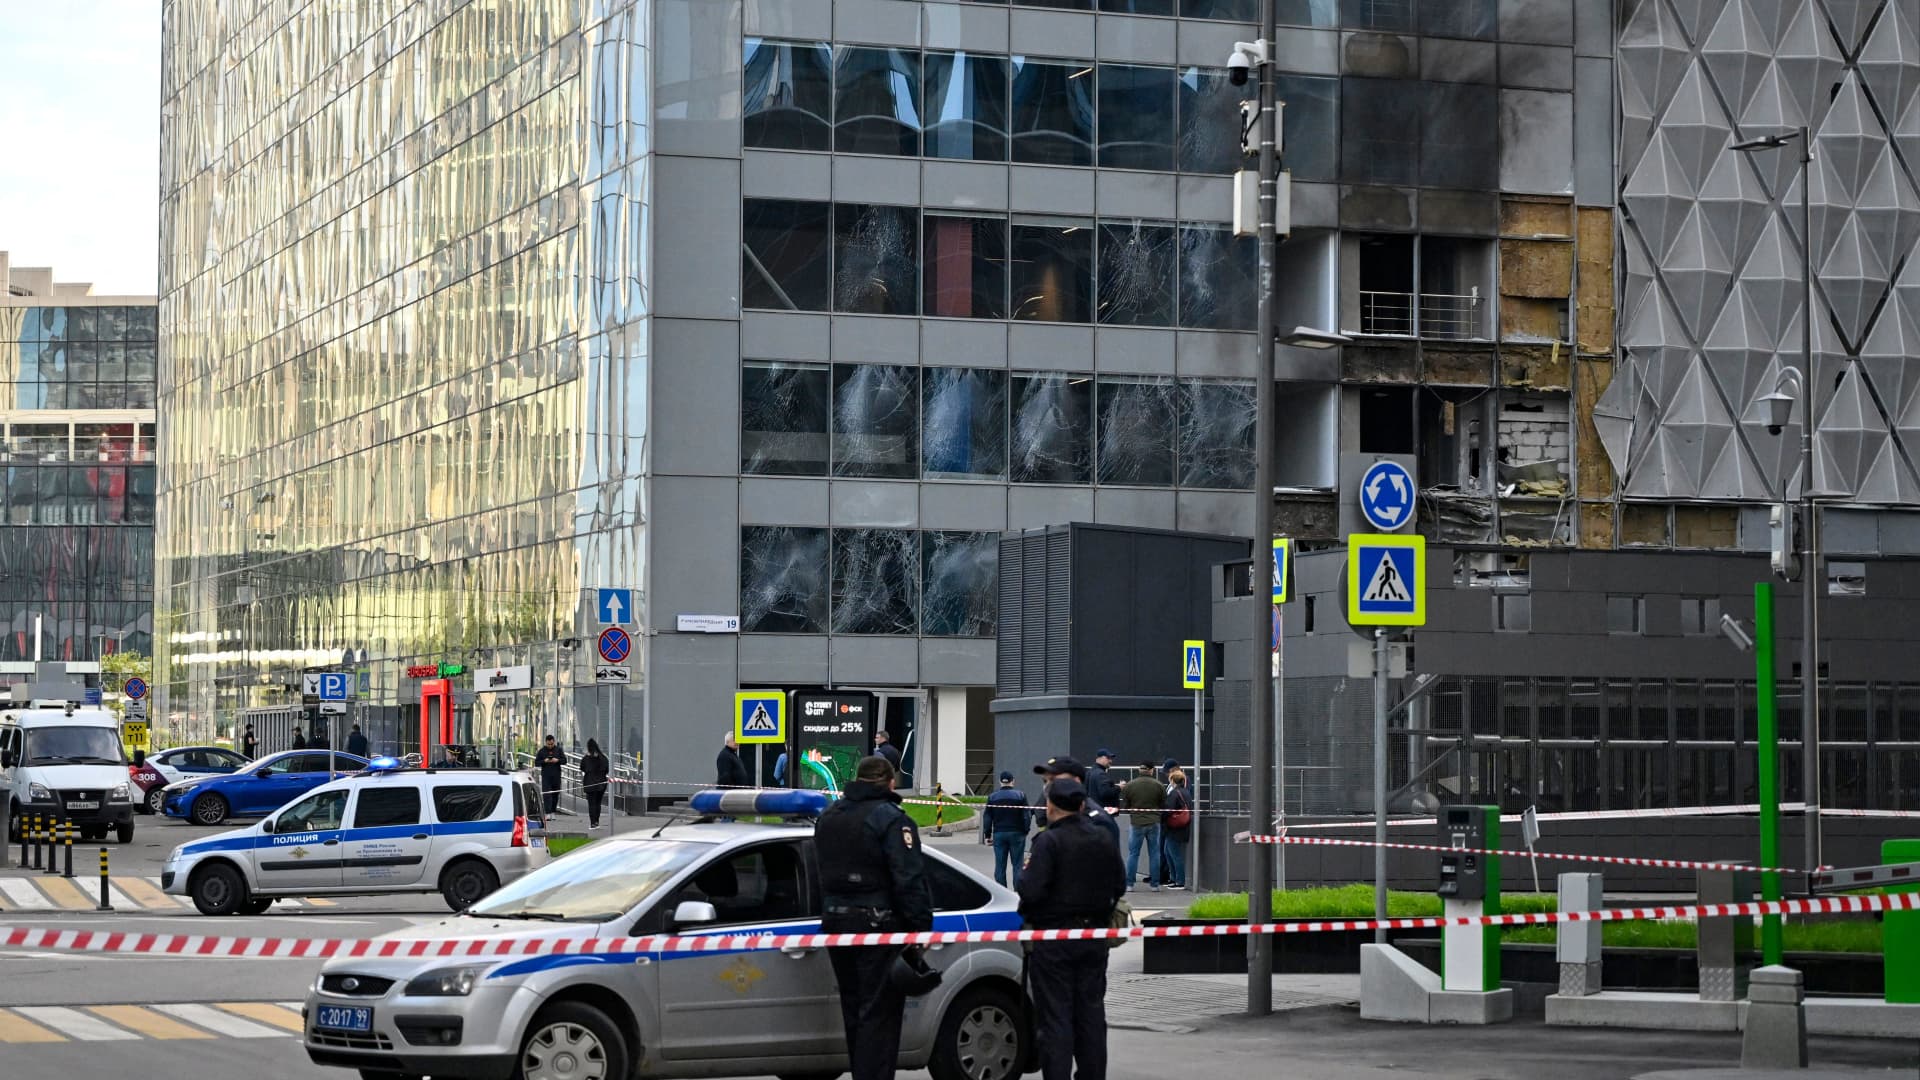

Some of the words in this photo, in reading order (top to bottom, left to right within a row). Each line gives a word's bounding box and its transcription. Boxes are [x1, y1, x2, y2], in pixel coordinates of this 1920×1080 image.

[727, 619, 737, 629] 19
[407, 664, 438, 678] EUROSPAR
[325, 675, 341, 697] P
[813, 701, 832, 709] SYDNEY
[813, 708, 825, 716] CITY
[803, 725, 829, 733] скидки
[830, 725, 840, 733] до
[841, 722, 863, 732] 25%
[138, 773, 157, 781] 308
[273, 834, 319, 845] ПОЛИЦИЯ
[328, 1009, 351, 1026] 2017
[357, 1010, 367, 1023] 99
